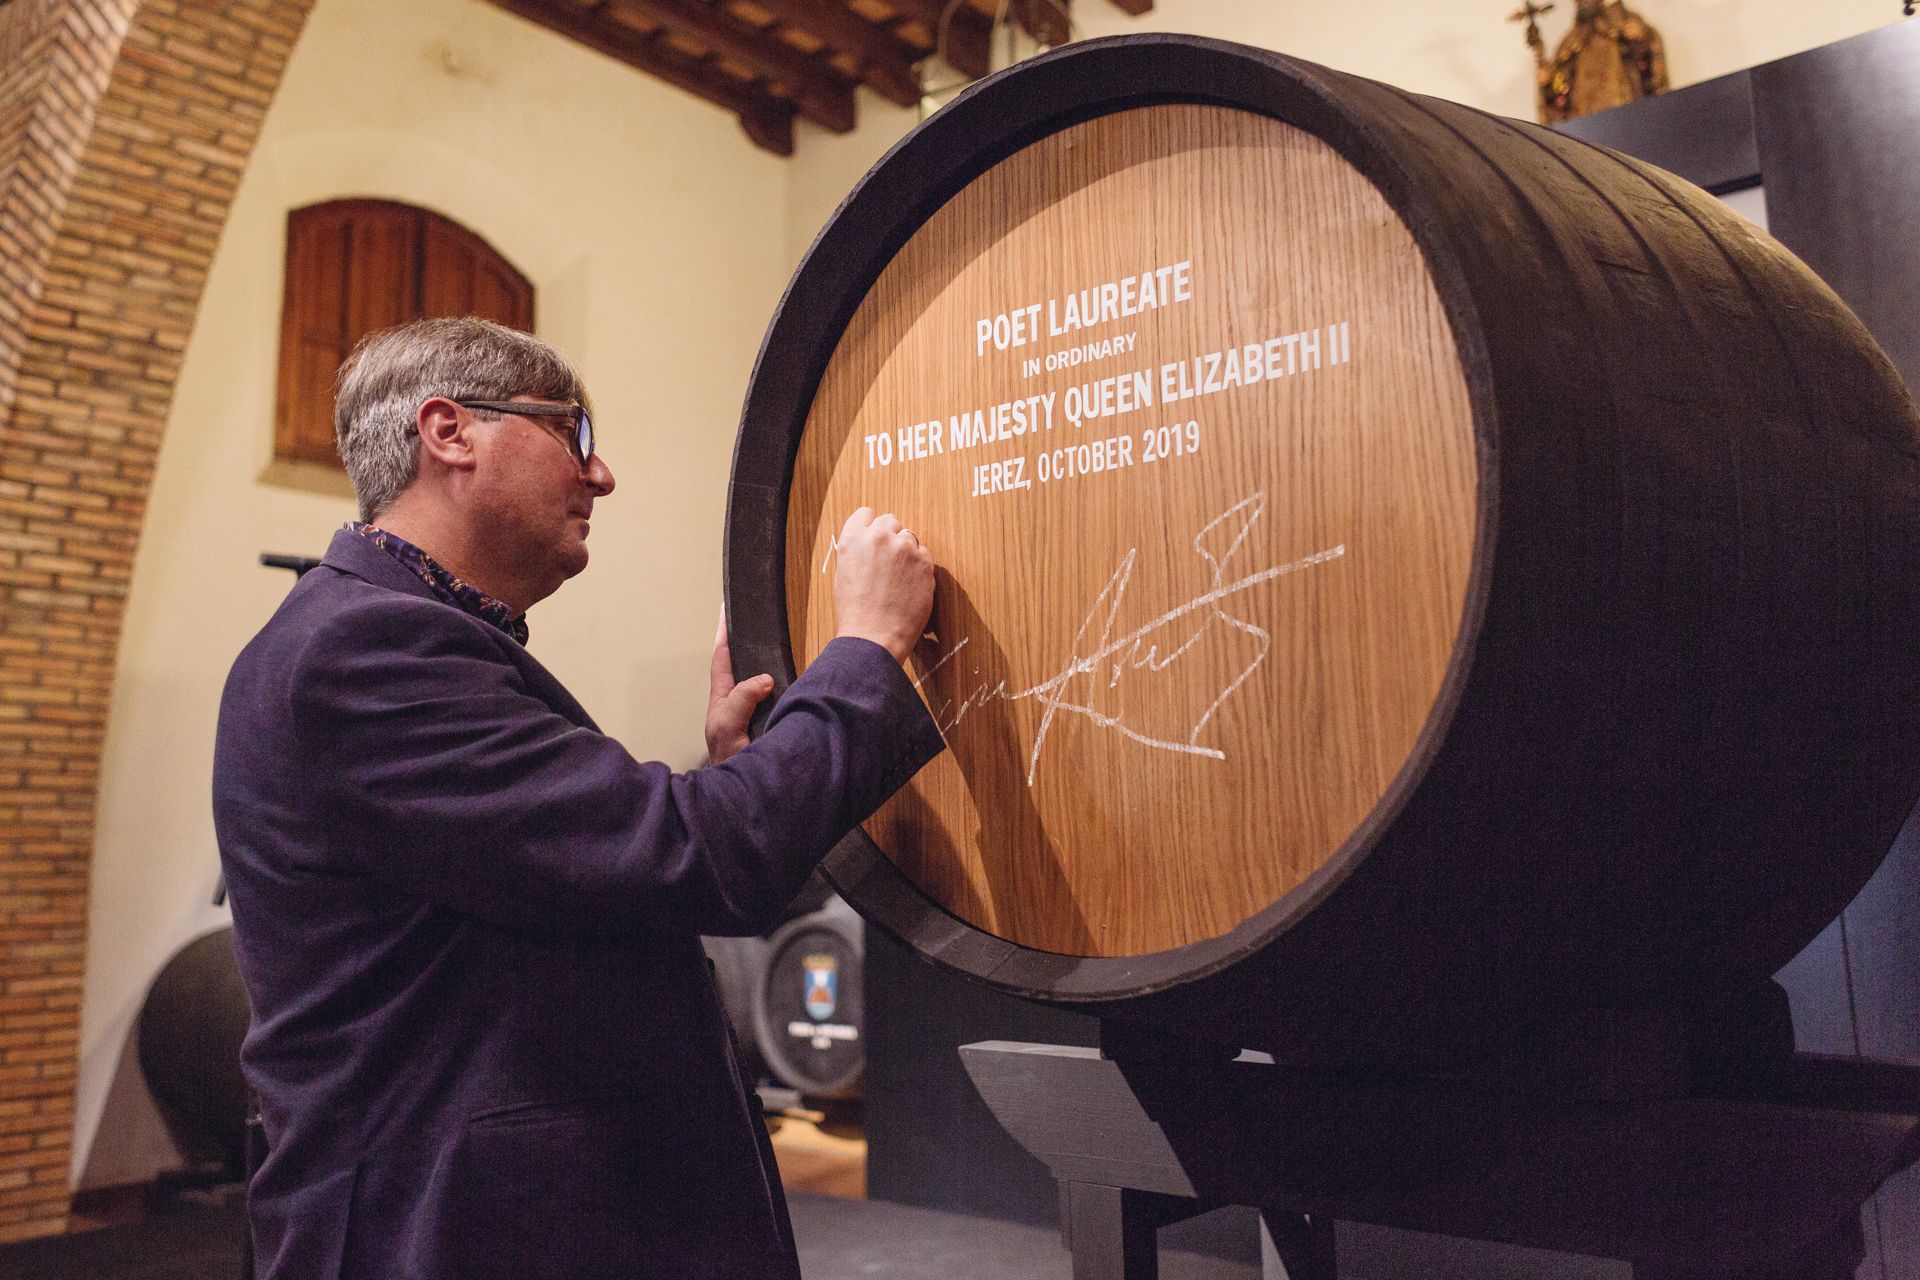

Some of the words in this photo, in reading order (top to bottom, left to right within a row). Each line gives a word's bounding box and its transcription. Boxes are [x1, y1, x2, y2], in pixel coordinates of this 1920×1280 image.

[976, 303, 1042, 358] POET
[1049, 260, 1192, 337] LAUREATE
[865, 434, 893, 470] TO
[898, 420, 943, 463] HER
[949, 392, 1057, 452] MAJESTY
[1064, 368, 1153, 428] QUEEN
[1161, 329, 1322, 404] ELIZABETH
[1328, 321, 1351, 366] II
[1022, 358, 1041, 379] IN
[1045, 332, 1137, 373] ORDINARY
[972, 457, 1032, 497] JEREZ,
[1038, 434, 1133, 483] OCTOBER
[1142, 420, 1201, 463] 2019
